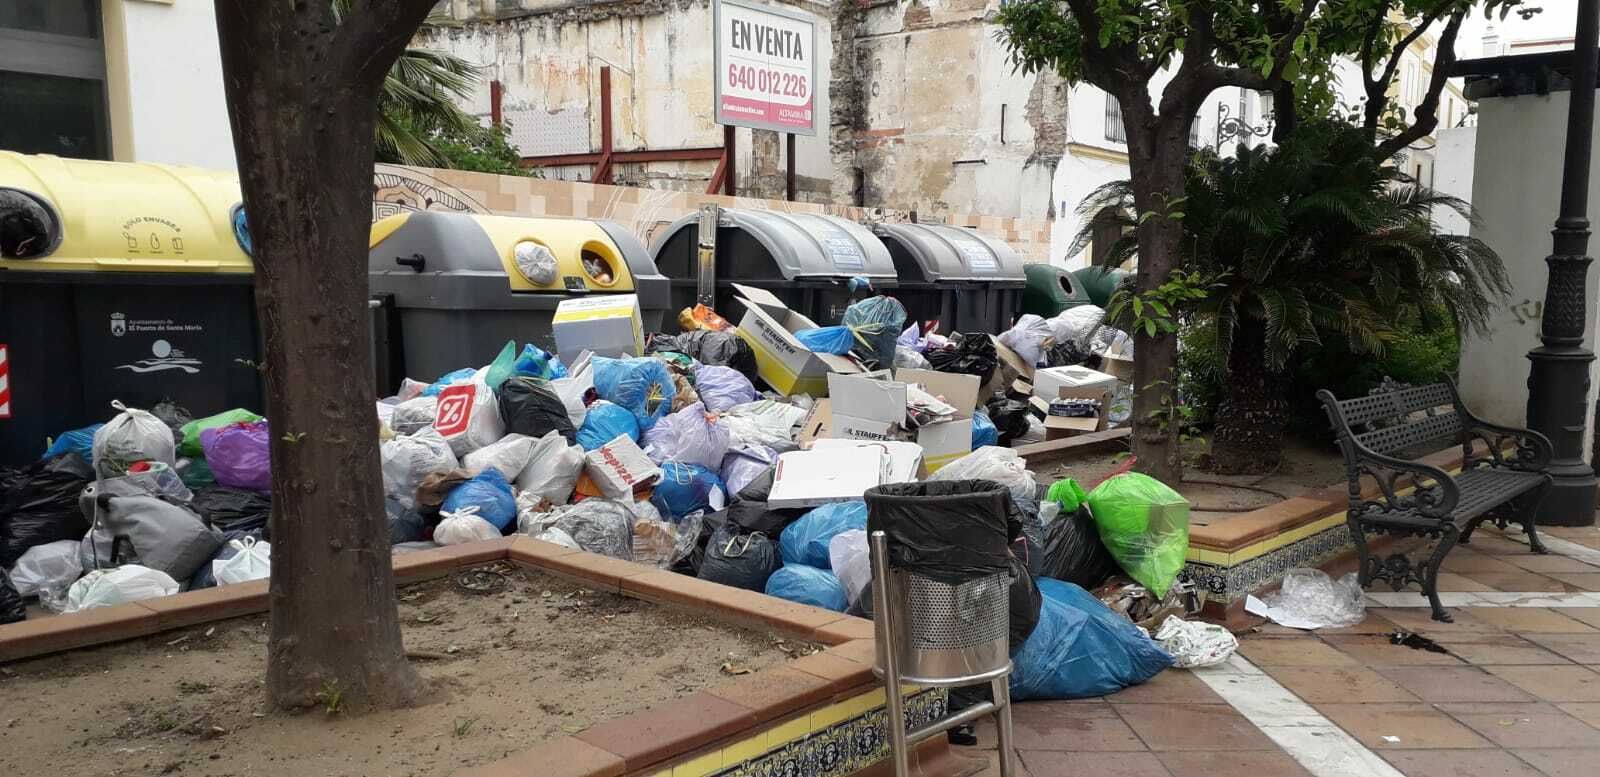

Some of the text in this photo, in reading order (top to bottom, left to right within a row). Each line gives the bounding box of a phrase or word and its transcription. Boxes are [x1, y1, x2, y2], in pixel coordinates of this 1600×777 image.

[731, 19, 803, 60] EN VENTA
[729, 63, 806, 98] 640 012 226
[765, 328, 796, 354] STAUFFER
